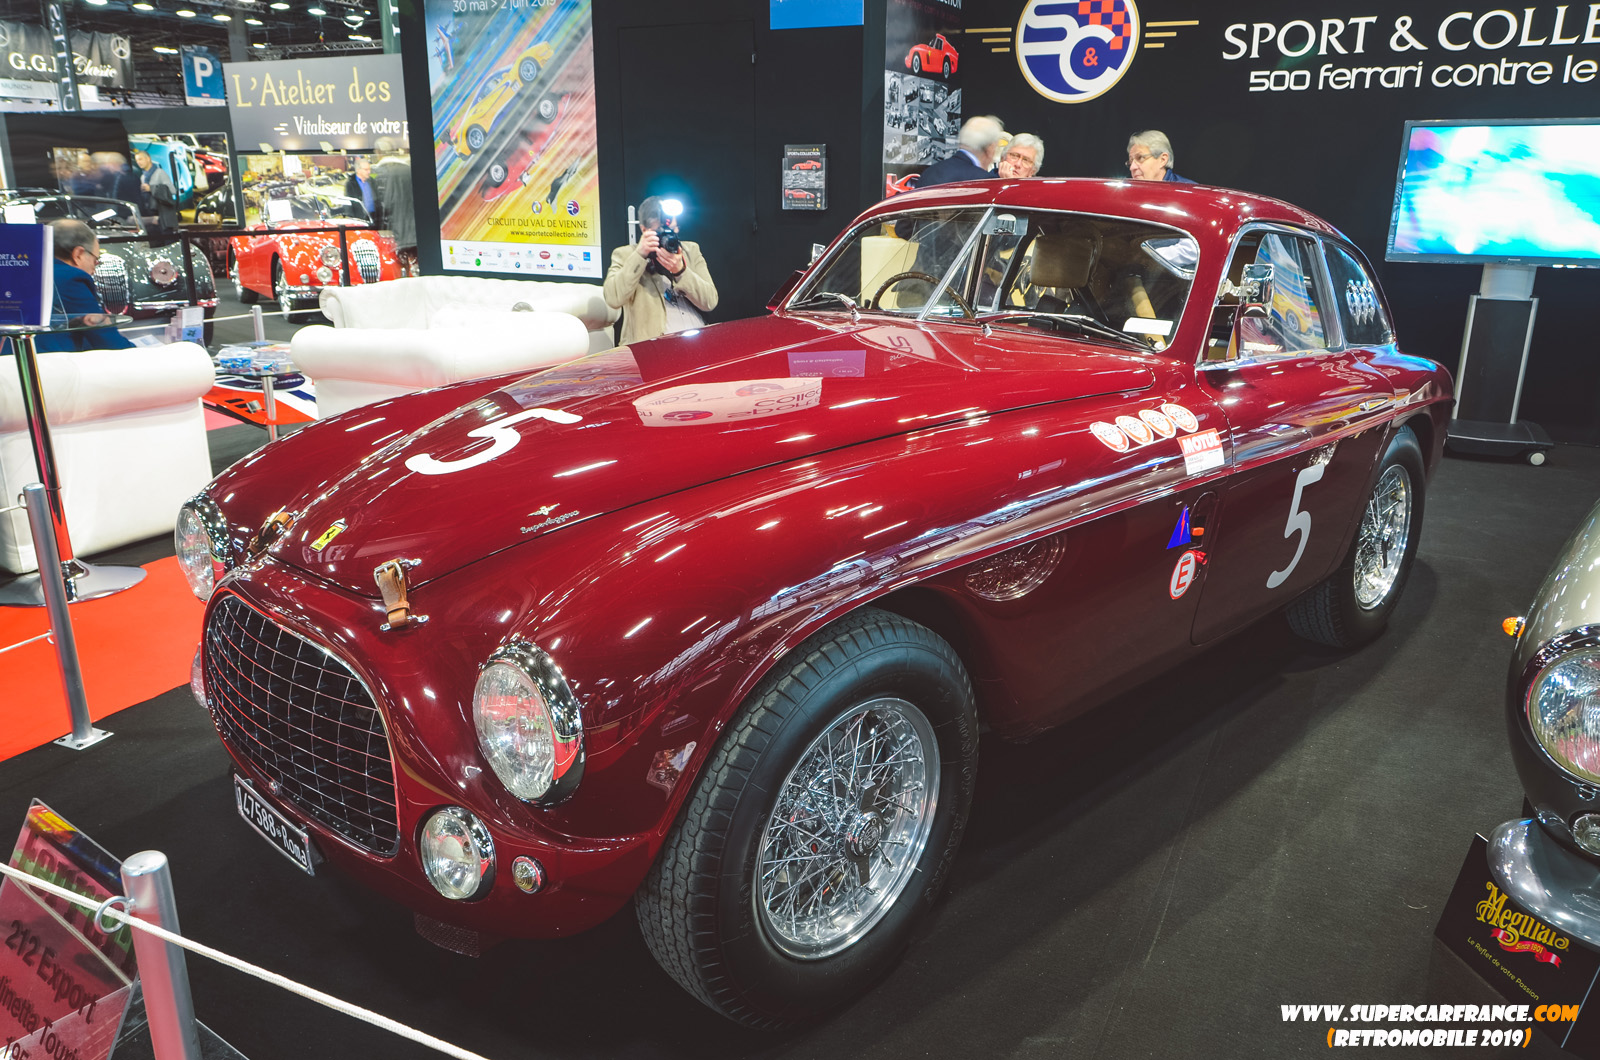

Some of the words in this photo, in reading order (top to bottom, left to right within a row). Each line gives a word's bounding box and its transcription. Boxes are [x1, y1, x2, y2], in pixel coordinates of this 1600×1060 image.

[1222, 15, 1378, 60] SPORT
[1389, 15, 1429, 52] &
[193, 56, 214, 88] P
[232, 69, 336, 107] L'Atelier
[348, 67, 392, 104] des
[1249, 69, 1311, 92] 500
[1431, 56, 1554, 87] contre
[1563, 54, 1598, 84] le
[293, 113, 352, 136] Vitaliseur
[354, 113, 367, 135] de
[370, 117, 400, 135] votre
[487, 217, 515, 227] CIRCUIT
[517, 218, 529, 227] DU
[530, 219, 546, 228] VAL
[547, 220, 557, 228] DE
[559, 220, 588, 229] VIENNE
[510, 230, 588, 239] www.sportetcollection.info
[404, 407, 583, 476] 5
[1181, 431, 1221, 455] MOTUL
[1265, 463, 1325, 589] 5
[1175, 559, 1192, 590] E
[281, 824, 308, 867] Roma
[1515, 942, 1532, 951] Since
[1531, 943, 1544, 954] 1901
[4, 919, 39, 968] 212
[36, 945, 99, 1025] Export
[1467, 936, 1475, 946] Le
[1474, 942, 1493, 961] Reflet
[1492, 957, 1501, 967] de
[1500, 965, 1516, 981] votre
[1515, 978, 1540, 1001] Passion
